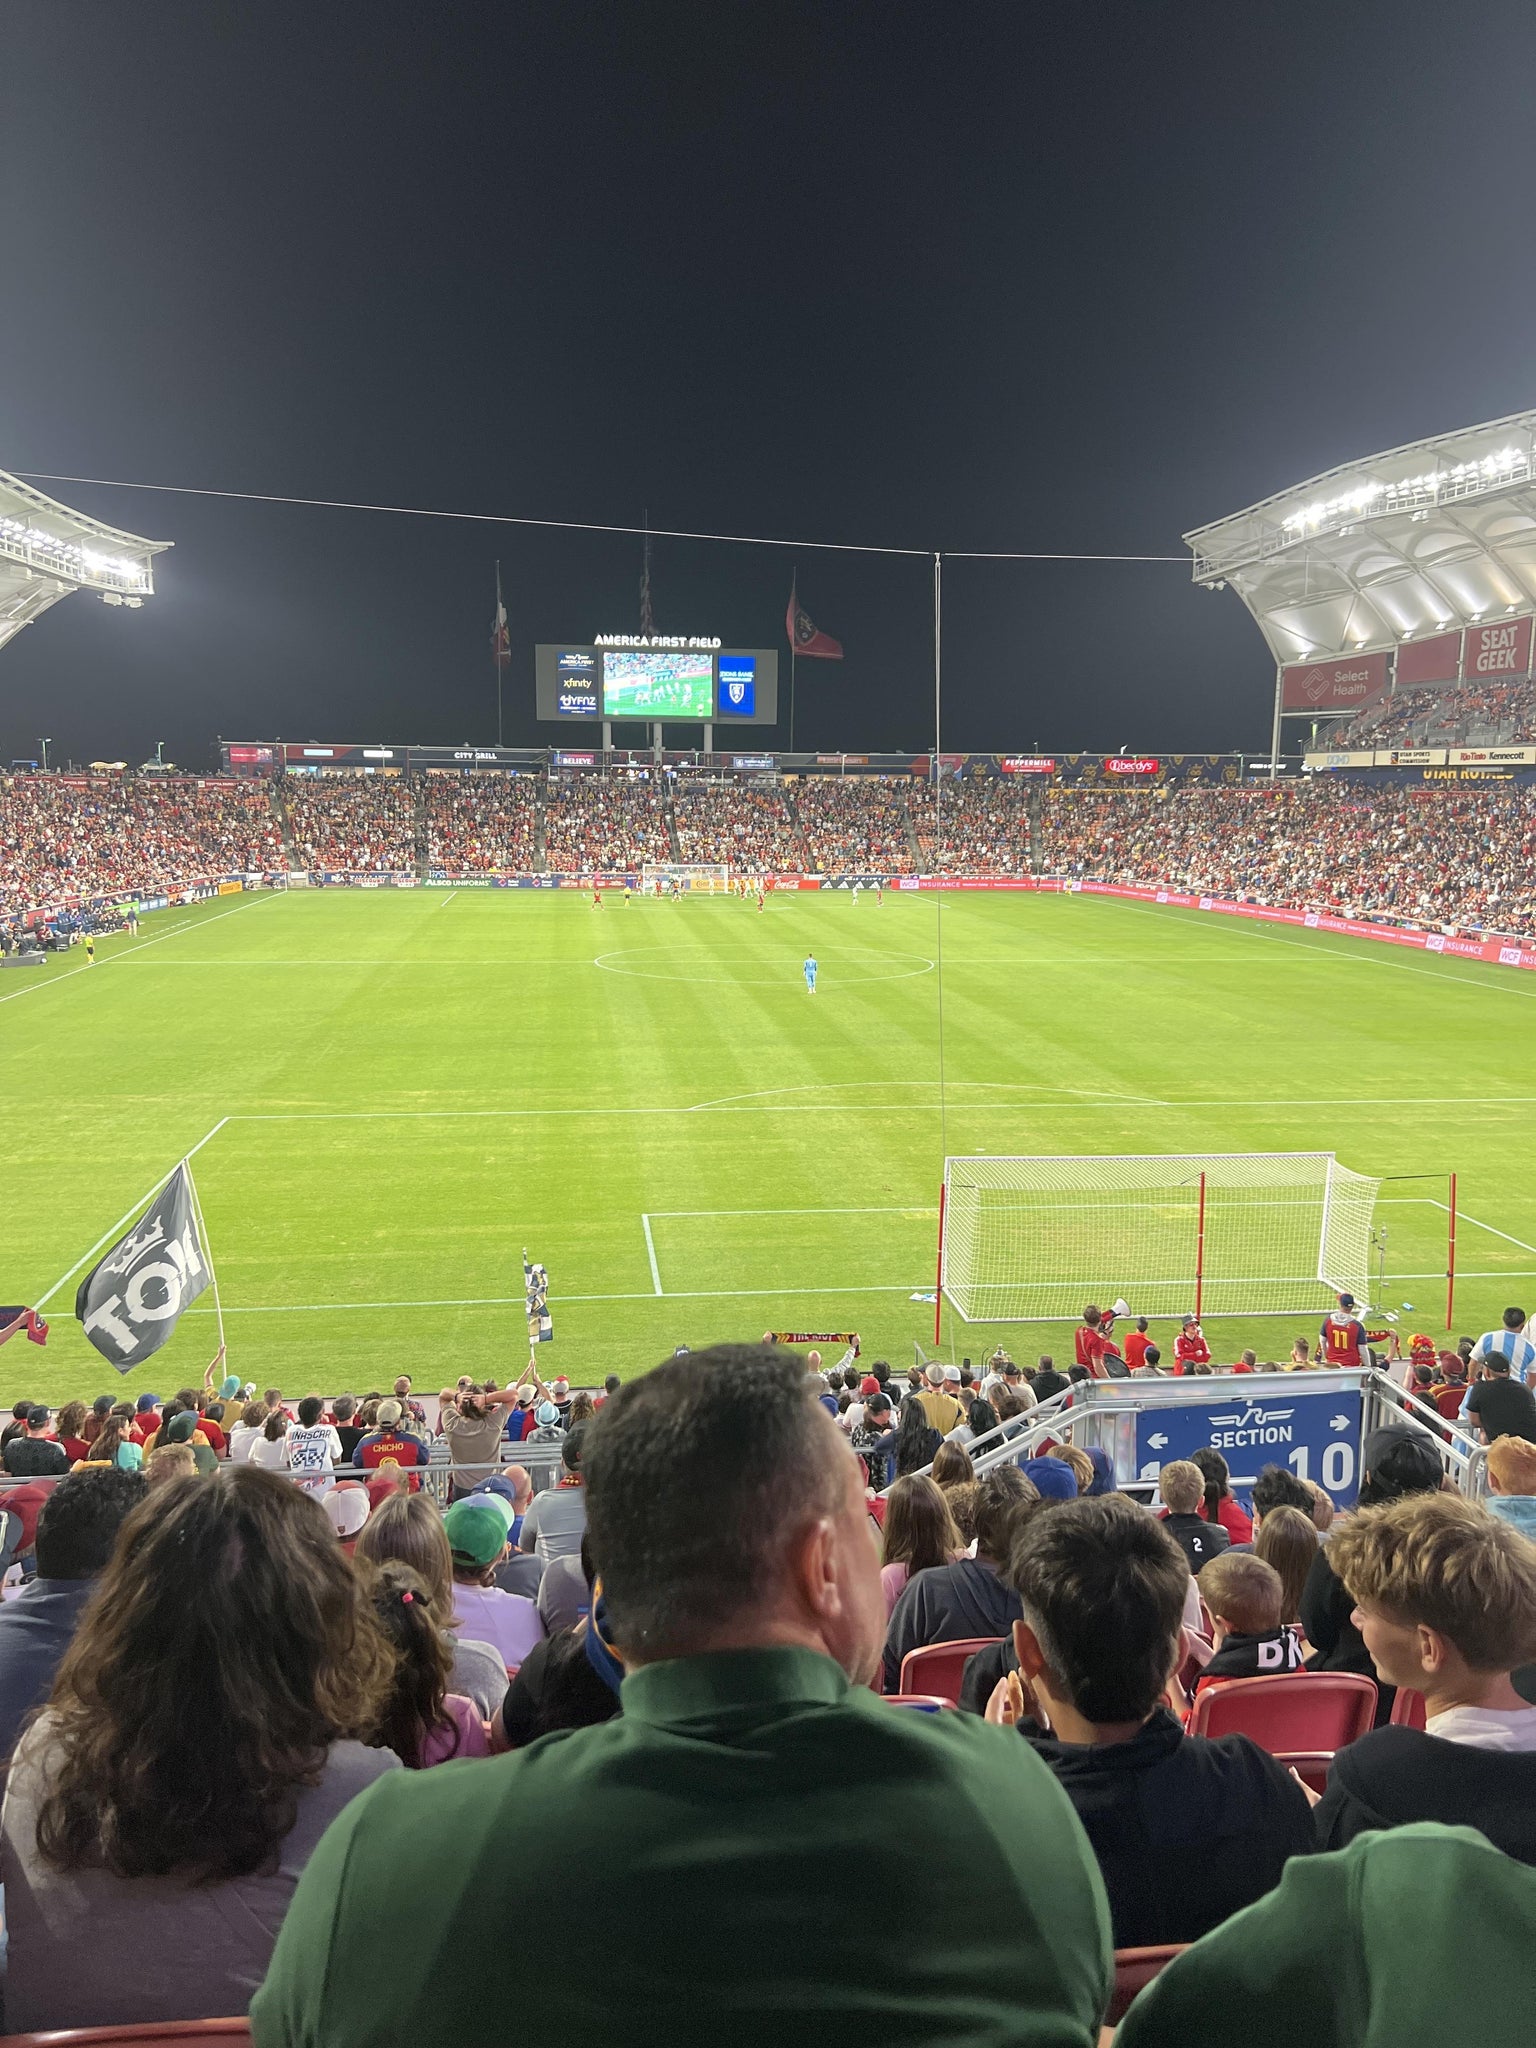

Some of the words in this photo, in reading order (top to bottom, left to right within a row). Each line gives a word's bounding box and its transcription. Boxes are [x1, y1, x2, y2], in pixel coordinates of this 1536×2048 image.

[594, 635, 650, 646] AMERICA
[652, 637, 687, 647] FIRST
[689, 637, 721, 648] FIELD
[1481, 626, 1518, 650] SEAT
[1477, 648, 1517, 671] GEEK
[1335, 670, 1369, 682] Select
[563, 678, 592, 688] xfinity
[1333, 683, 1367, 696] Health
[1489, 752, 1525, 760] Kennecott
[1427, 936, 1443, 947] WCF
[1444, 940, 1484, 955] INSURANCE
[1501, 951, 1519, 963] WCF
[1332, 1329, 1348, 1349] 11
[294, 1430, 331, 1440] NASCAR
[1210, 1425, 1292, 1449] SECTION
[373, 1442, 404, 1453] CHICHO
[1288, 1442, 1354, 1491] 10
[1193, 1537, 1203, 1552] 2
